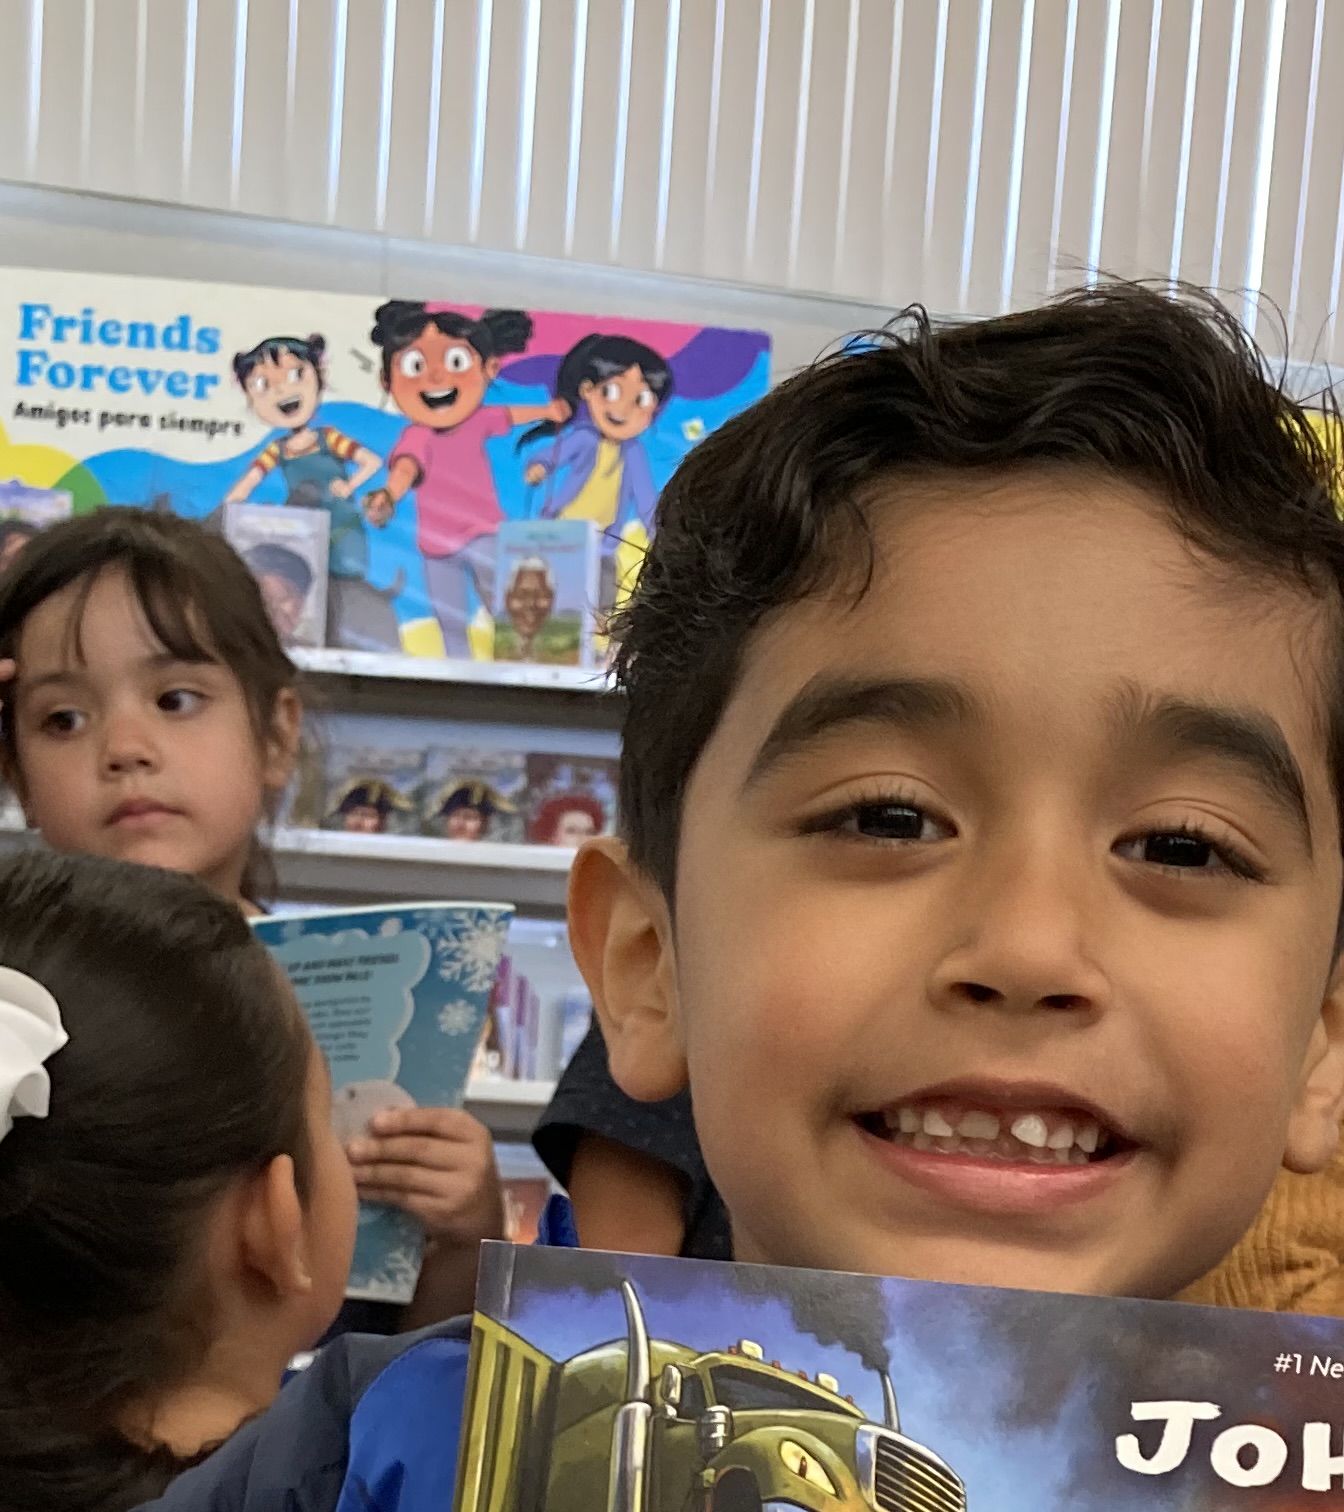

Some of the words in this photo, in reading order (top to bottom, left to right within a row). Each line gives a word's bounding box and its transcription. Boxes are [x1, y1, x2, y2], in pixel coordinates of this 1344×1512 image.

[19, 303, 223, 354] Friends
[16, 349, 222, 400] Forever
[13, 400, 93, 429] Amigos
[98, 410, 152, 433] para
[159, 413, 246, 441] siempre
[1273, 1351, 1304, 1375] #1
